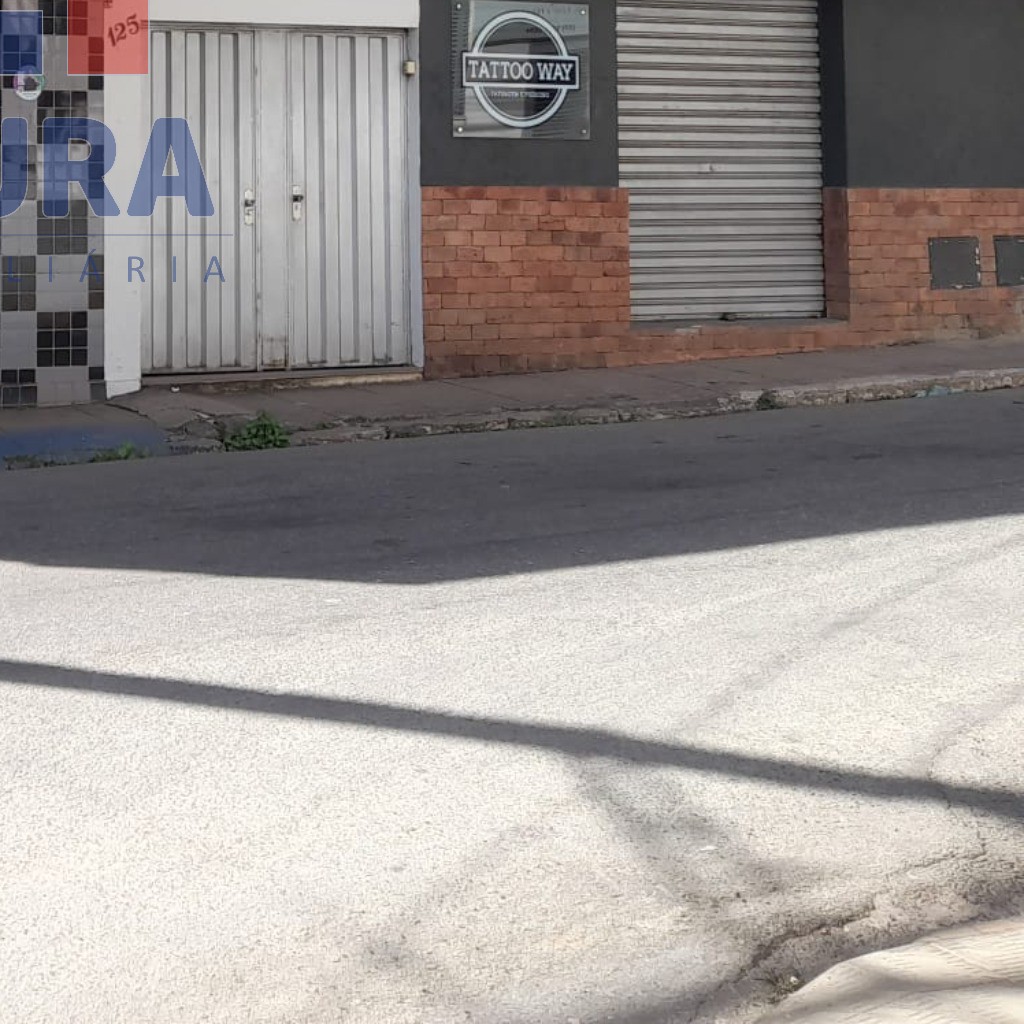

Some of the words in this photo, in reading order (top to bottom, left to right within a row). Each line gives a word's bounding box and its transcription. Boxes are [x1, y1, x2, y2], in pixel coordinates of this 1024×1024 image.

[107, 13, 140, 47] 125
[468, 59, 533, 80] TATTOO
[537, 62, 574, 81] WAY
